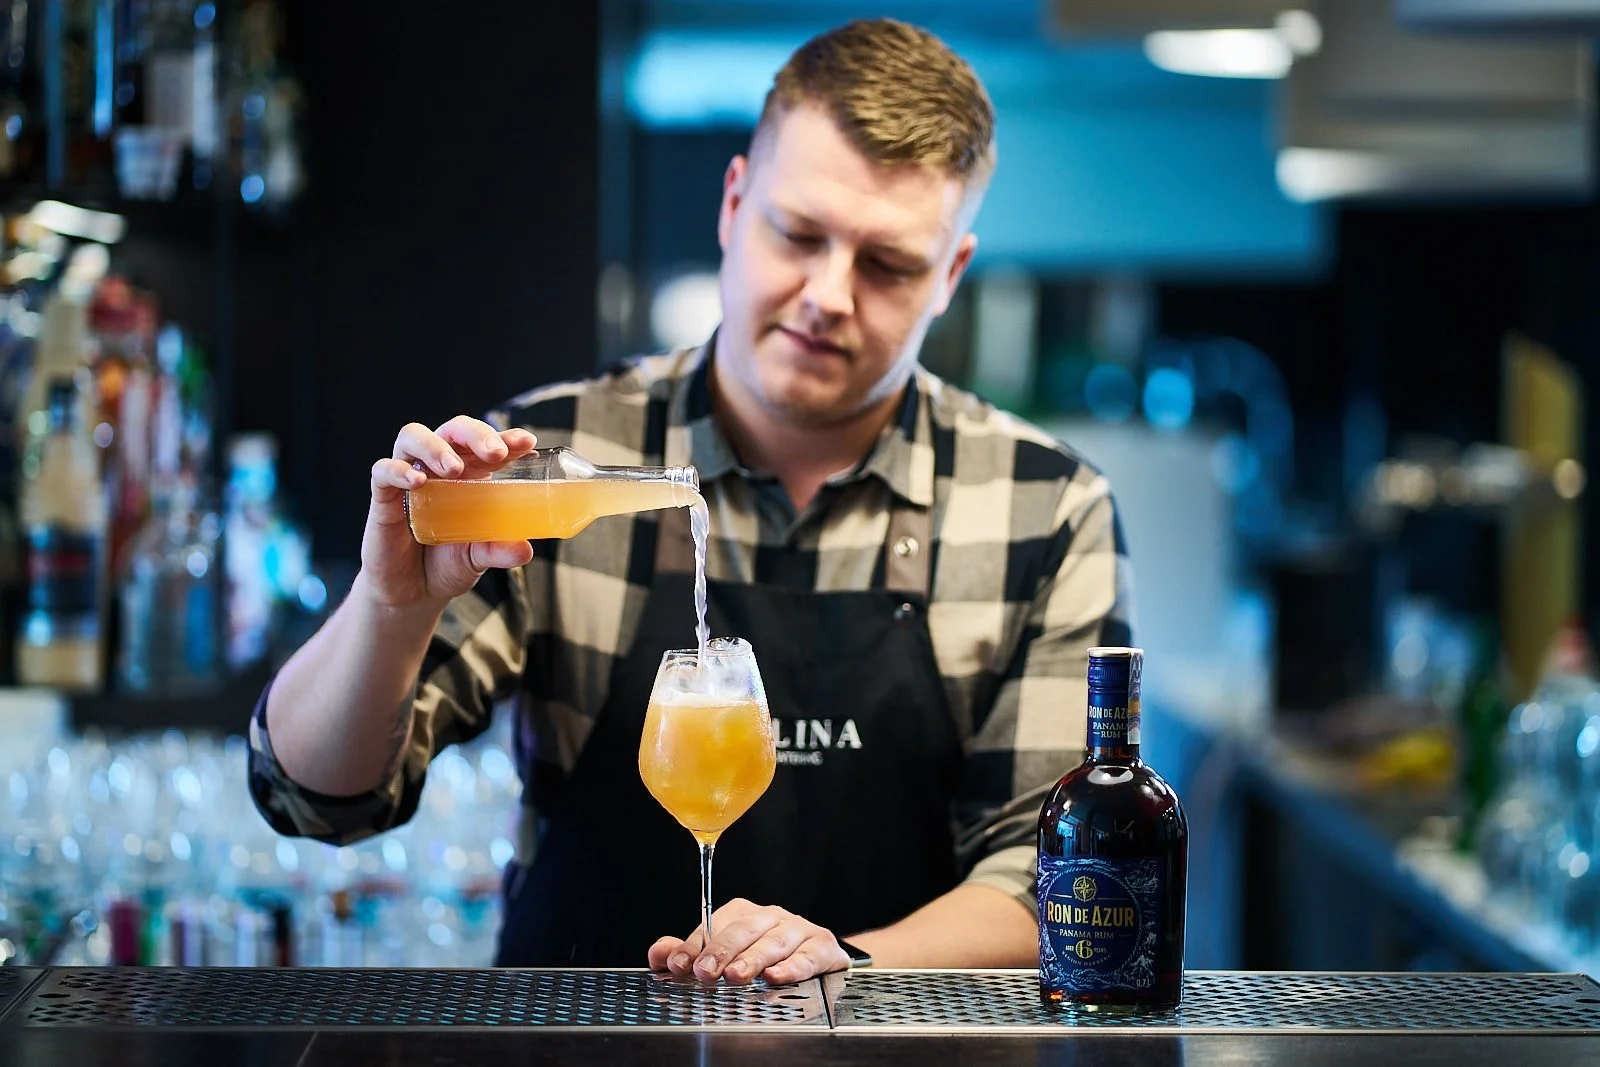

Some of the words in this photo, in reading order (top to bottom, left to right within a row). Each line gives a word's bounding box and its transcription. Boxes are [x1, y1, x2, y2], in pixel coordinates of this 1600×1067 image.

[1088, 704, 1103, 719] RON
[1103, 708, 1113, 718] DE
[1100, 730, 1121, 739] RUM
[1047, 900, 1072, 925] RON
[1074, 907, 1089, 924] DE
[1091, 905, 1134, 927] AZUR
[1059, 928, 1092, 939] PANAMA
[1094, 931, 1114, 939] RUM
[1075, 939, 1093, 959] 6
